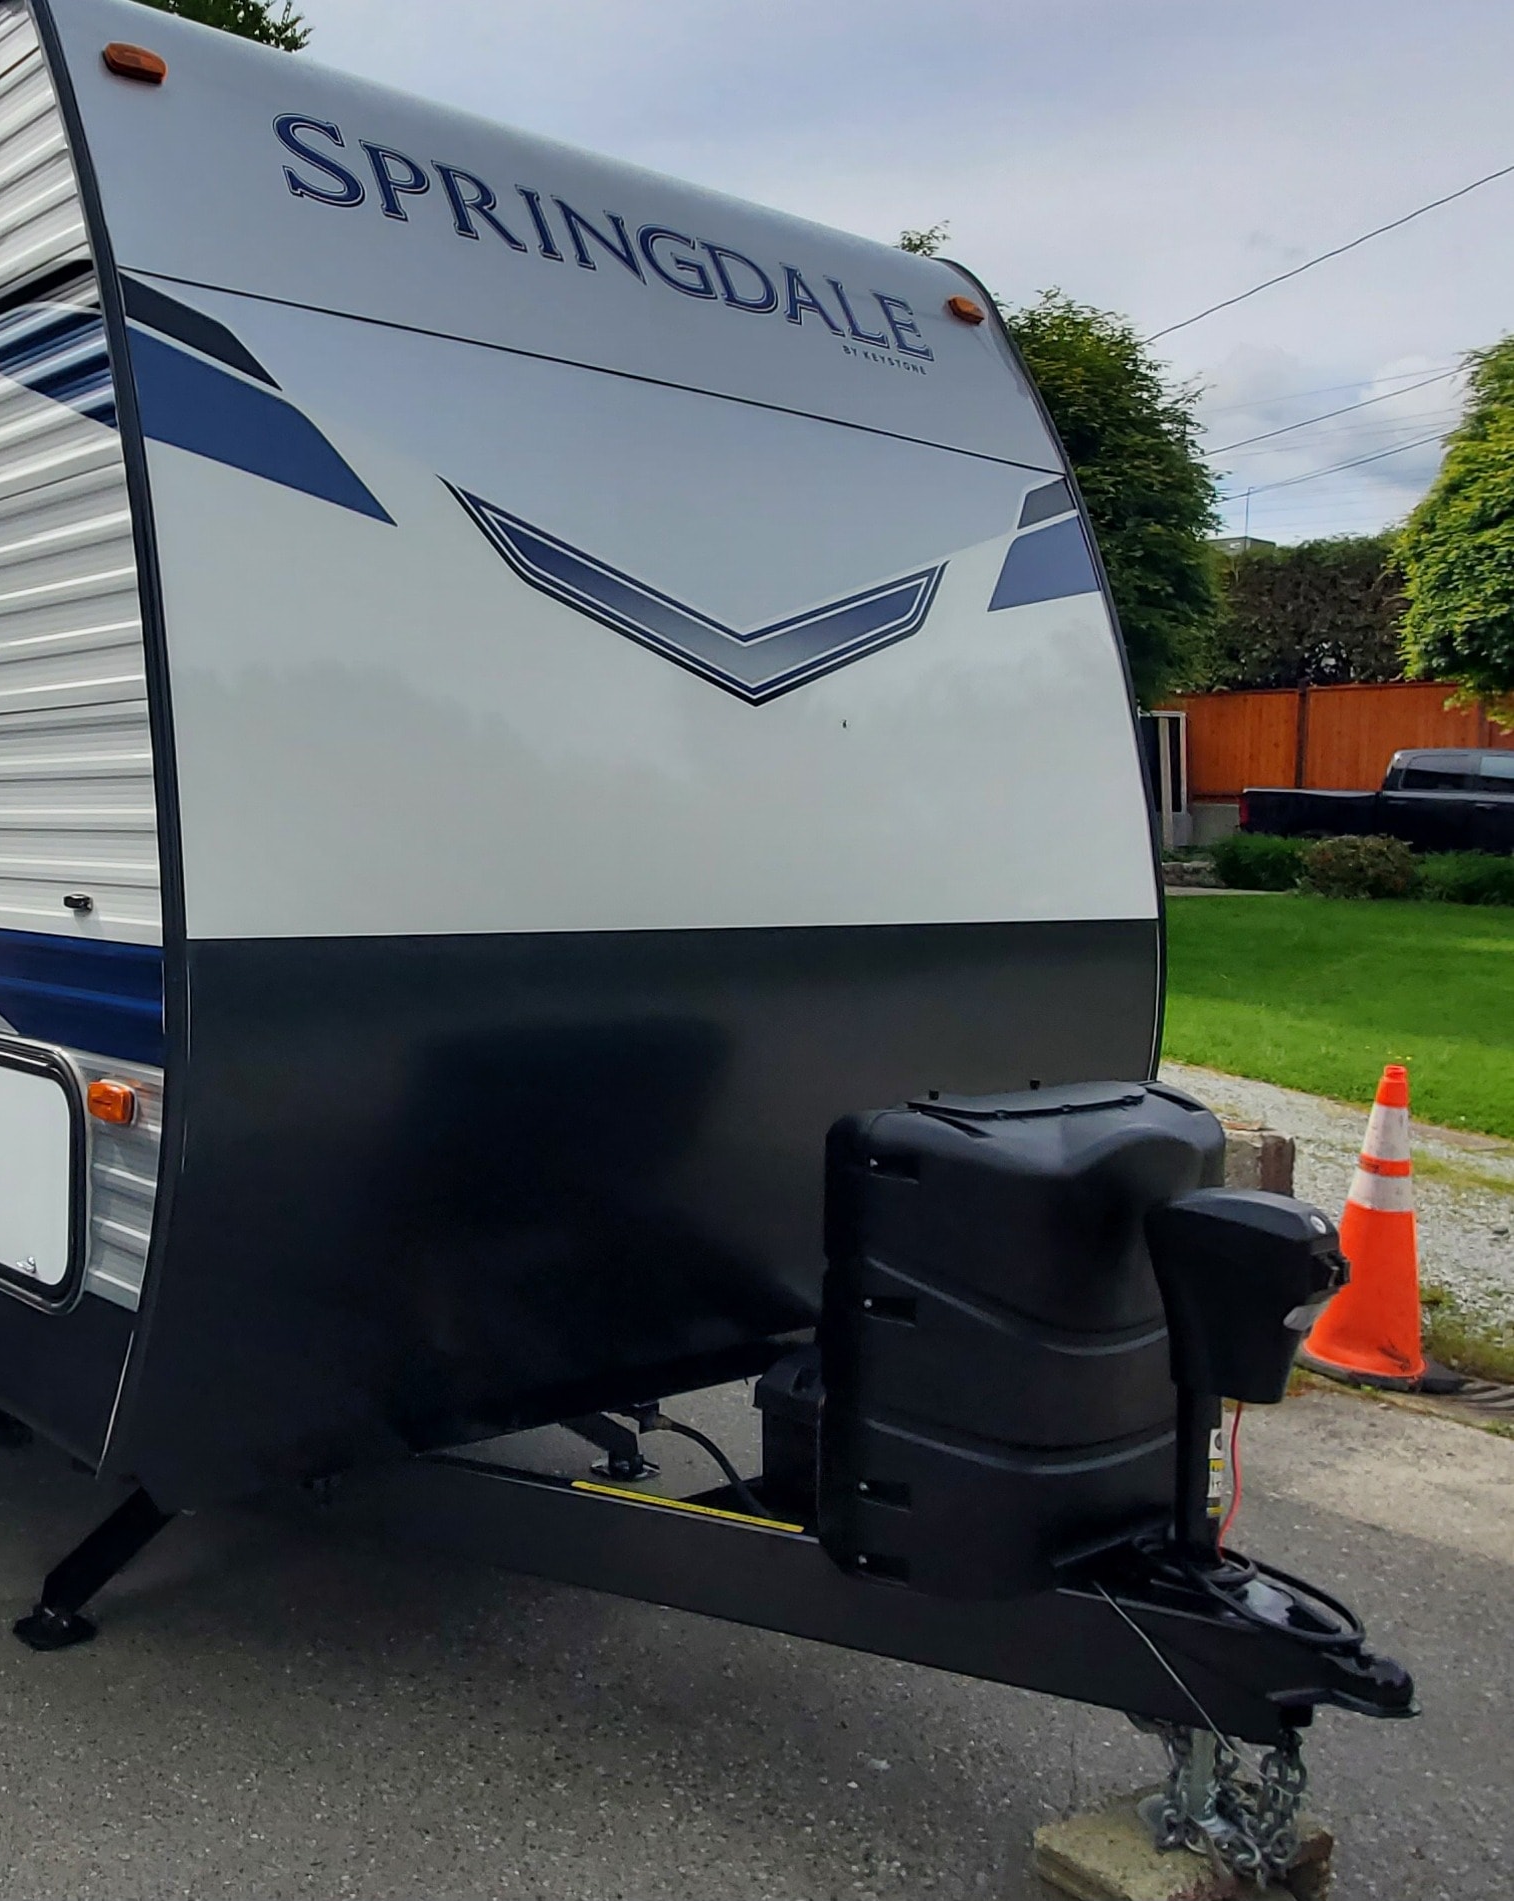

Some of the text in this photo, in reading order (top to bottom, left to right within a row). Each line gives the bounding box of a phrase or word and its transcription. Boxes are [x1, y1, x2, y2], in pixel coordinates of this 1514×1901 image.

[273, 113, 934, 361] SPRINGDALE
[842, 345, 927, 375] BY KEYSTONE
